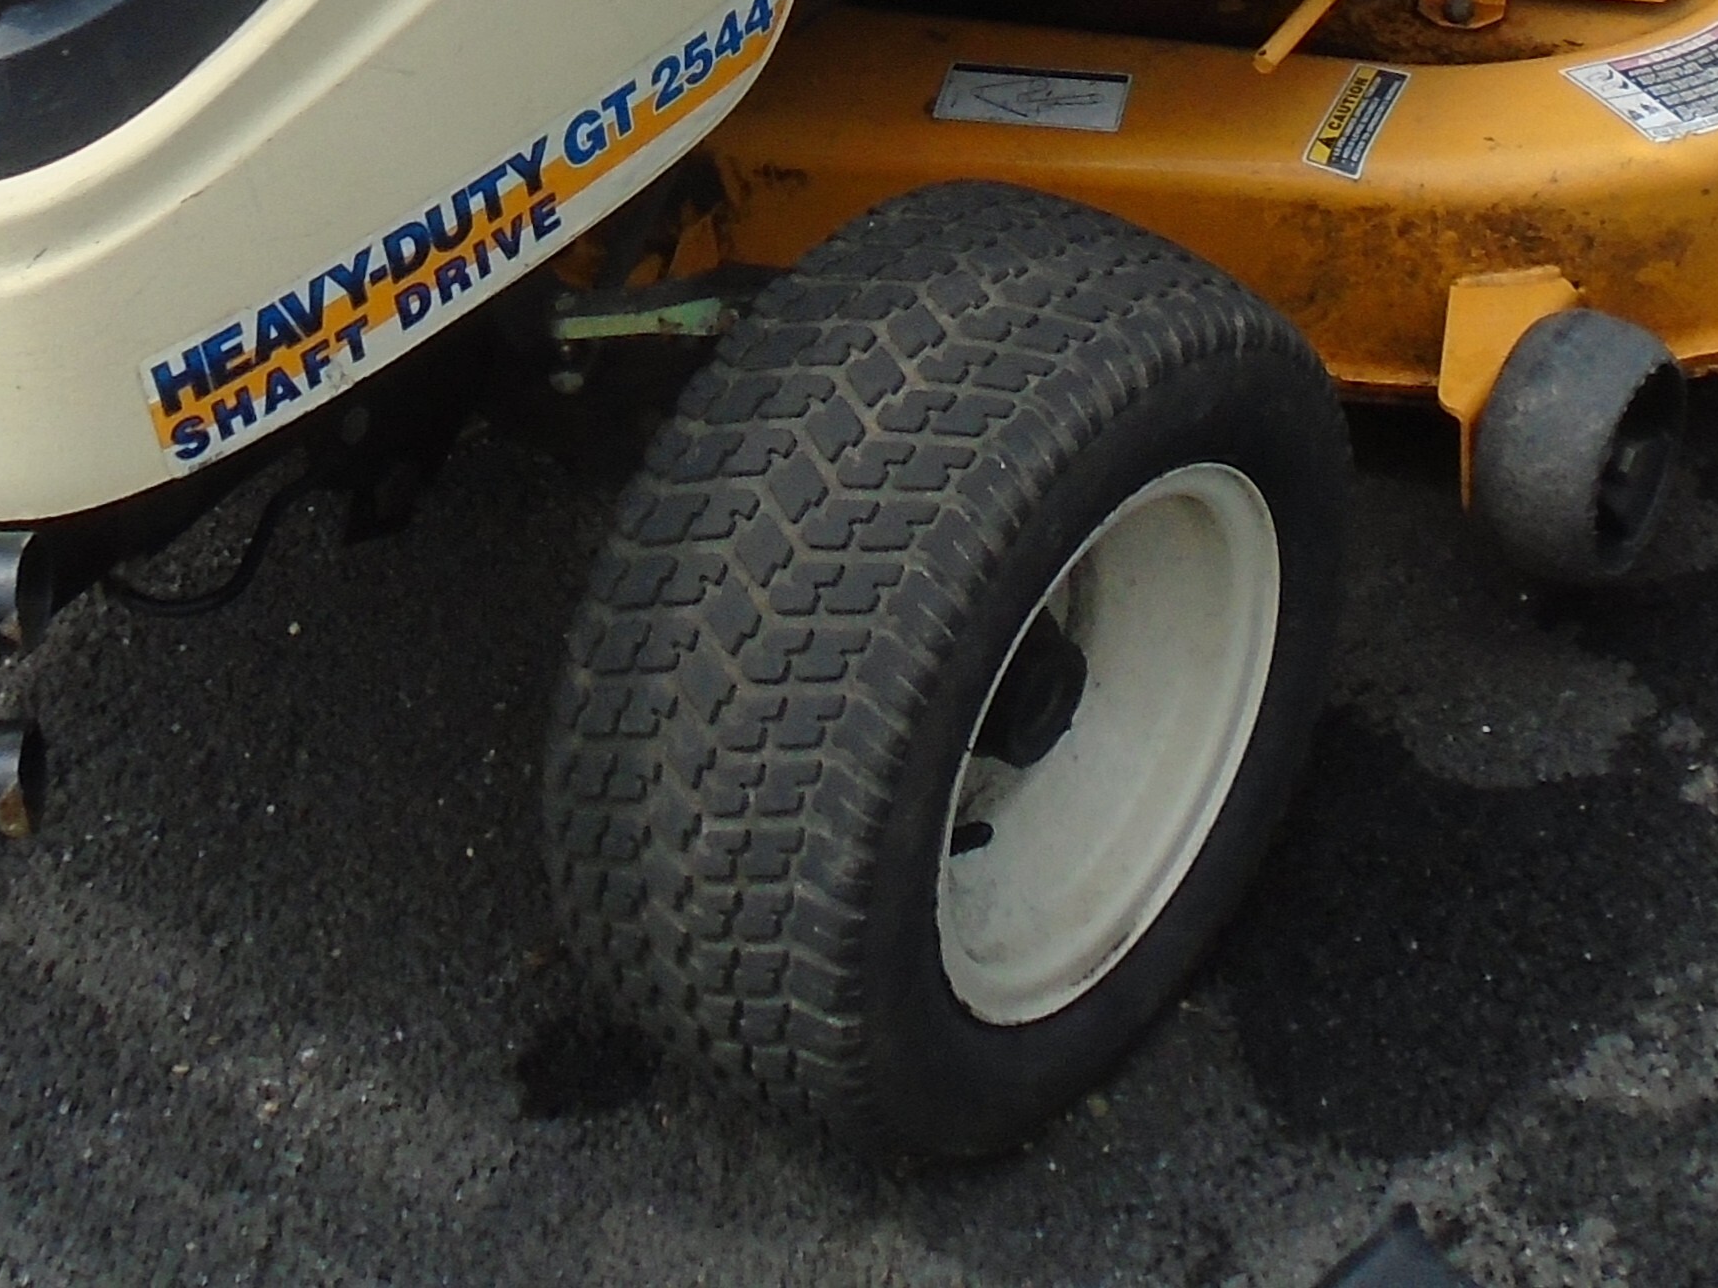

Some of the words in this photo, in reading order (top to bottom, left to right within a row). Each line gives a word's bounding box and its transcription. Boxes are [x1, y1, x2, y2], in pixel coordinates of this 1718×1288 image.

[1328, 77, 1370, 131] CAUTION
[149, 134, 550, 416] HEAVY-DUTY
[563, 85, 637, 167] GT
[170, 313, 369, 462] SHAFT
[394, 192, 562, 332] DRIVE
